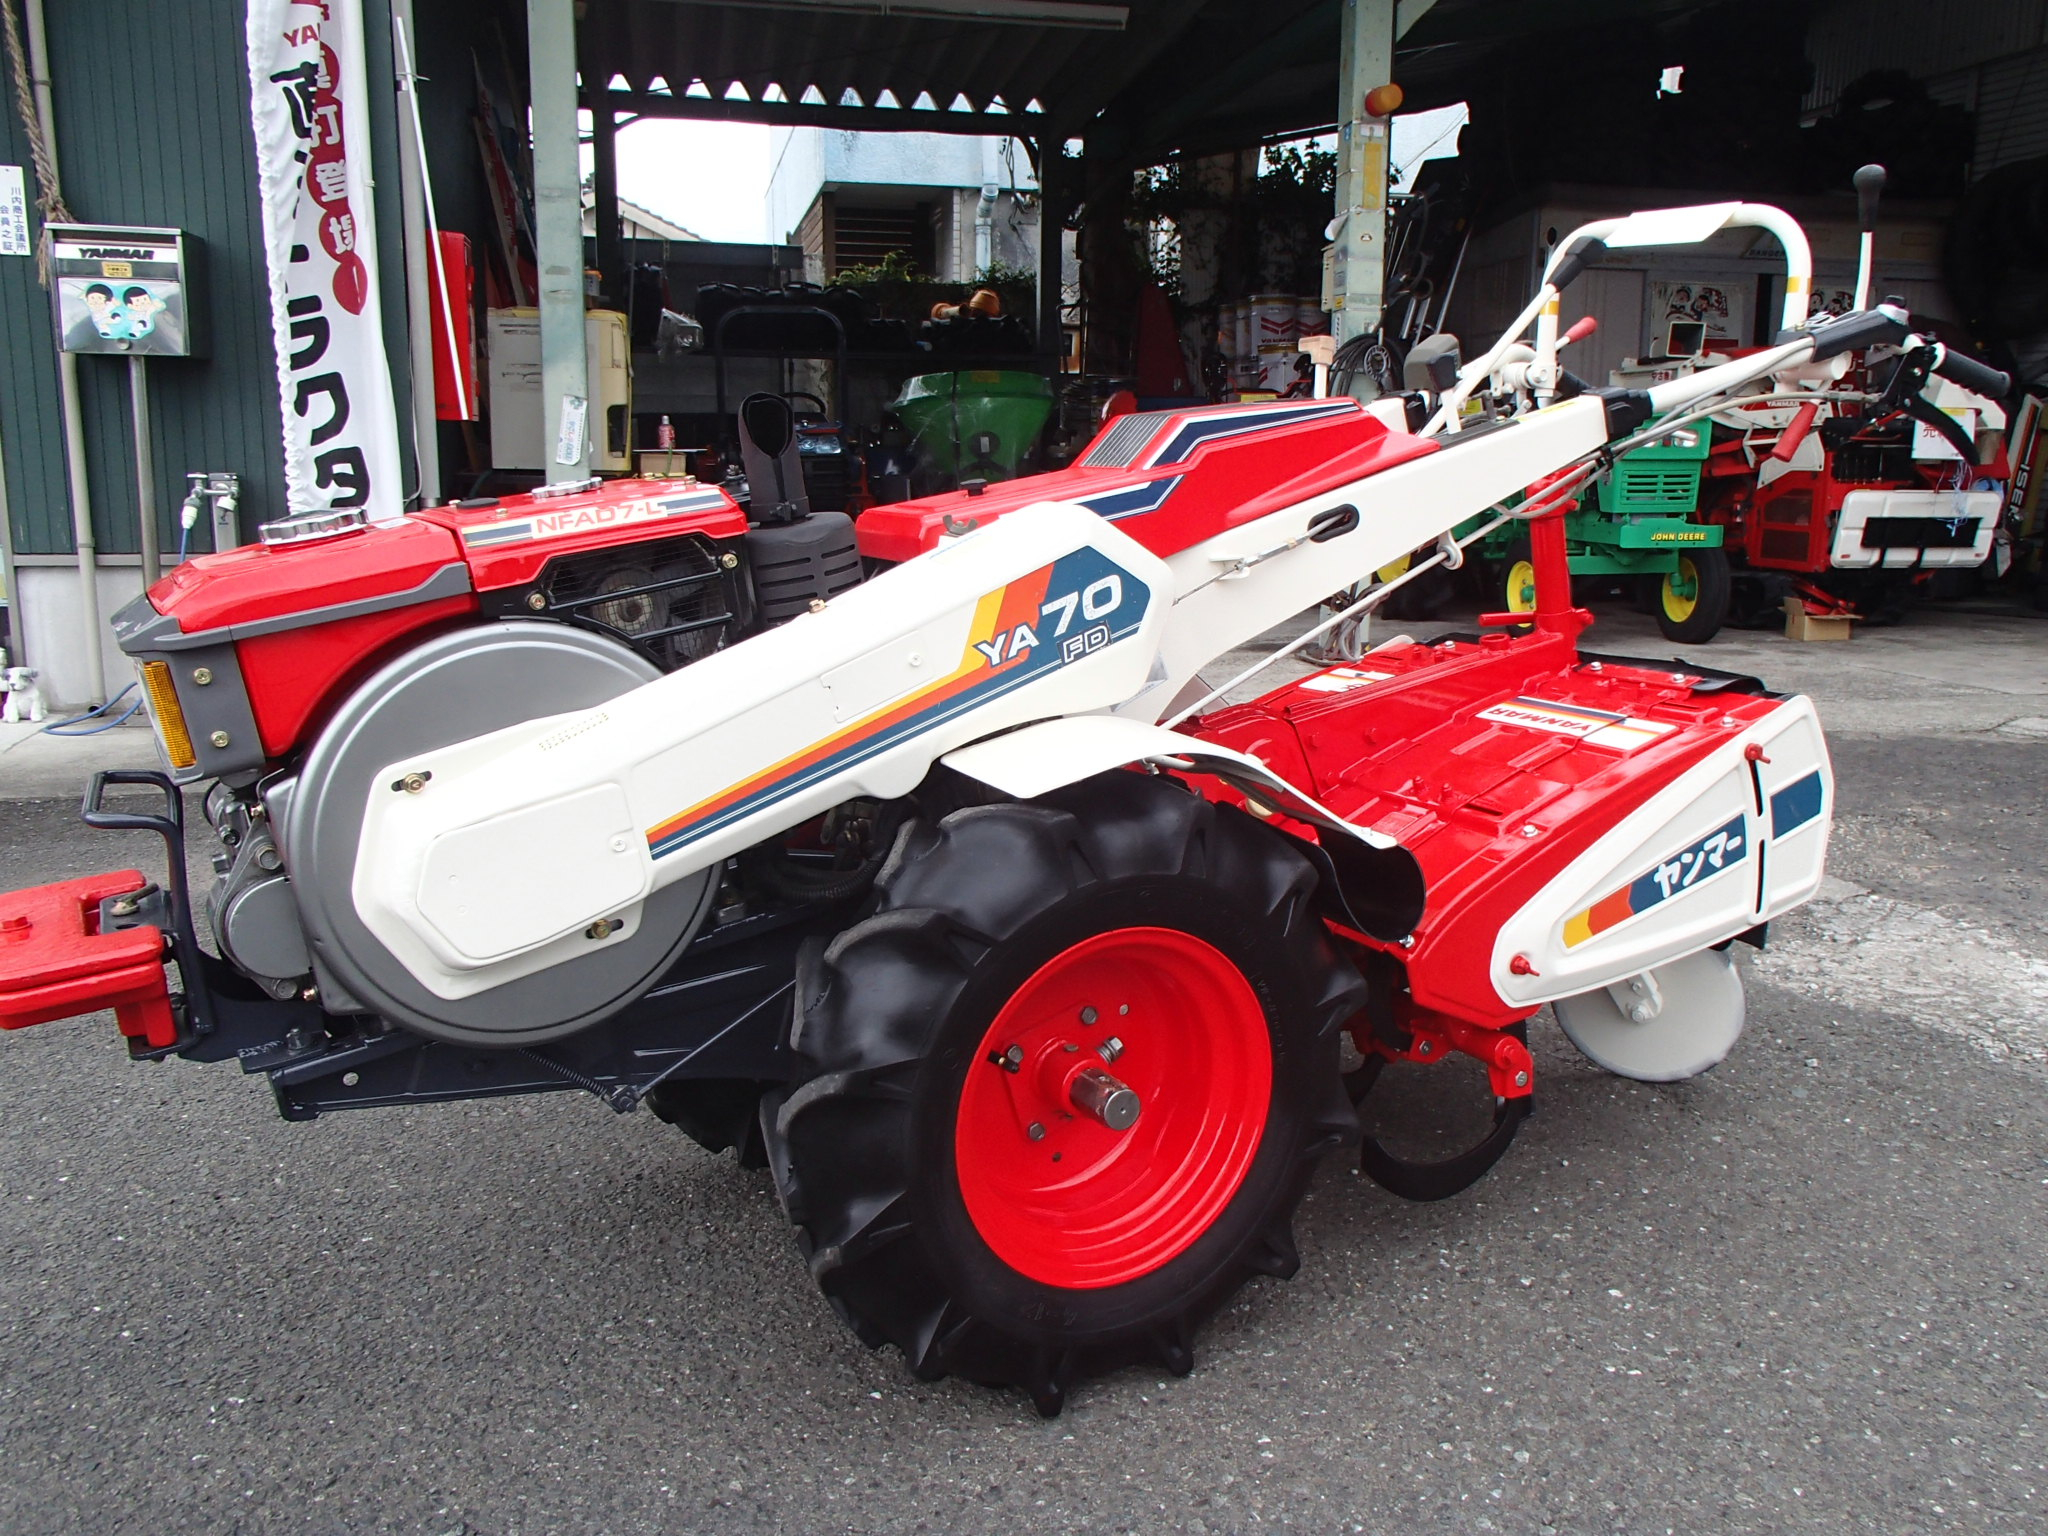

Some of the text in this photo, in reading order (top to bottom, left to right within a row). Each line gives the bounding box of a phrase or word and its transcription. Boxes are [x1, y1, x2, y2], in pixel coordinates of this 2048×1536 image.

[78, 248, 156, 260] YANMAR
[1766, 400, 1800, 408] YANMAR
[1651, 532, 1706, 541] JOHN DEERE
[975, 574, 1122, 666] YA 70
[1062, 623, 1110, 664] FD
[1488, 707, 1592, 732] YANMAR
[1653, 831, 1742, 899] ヤンマー
